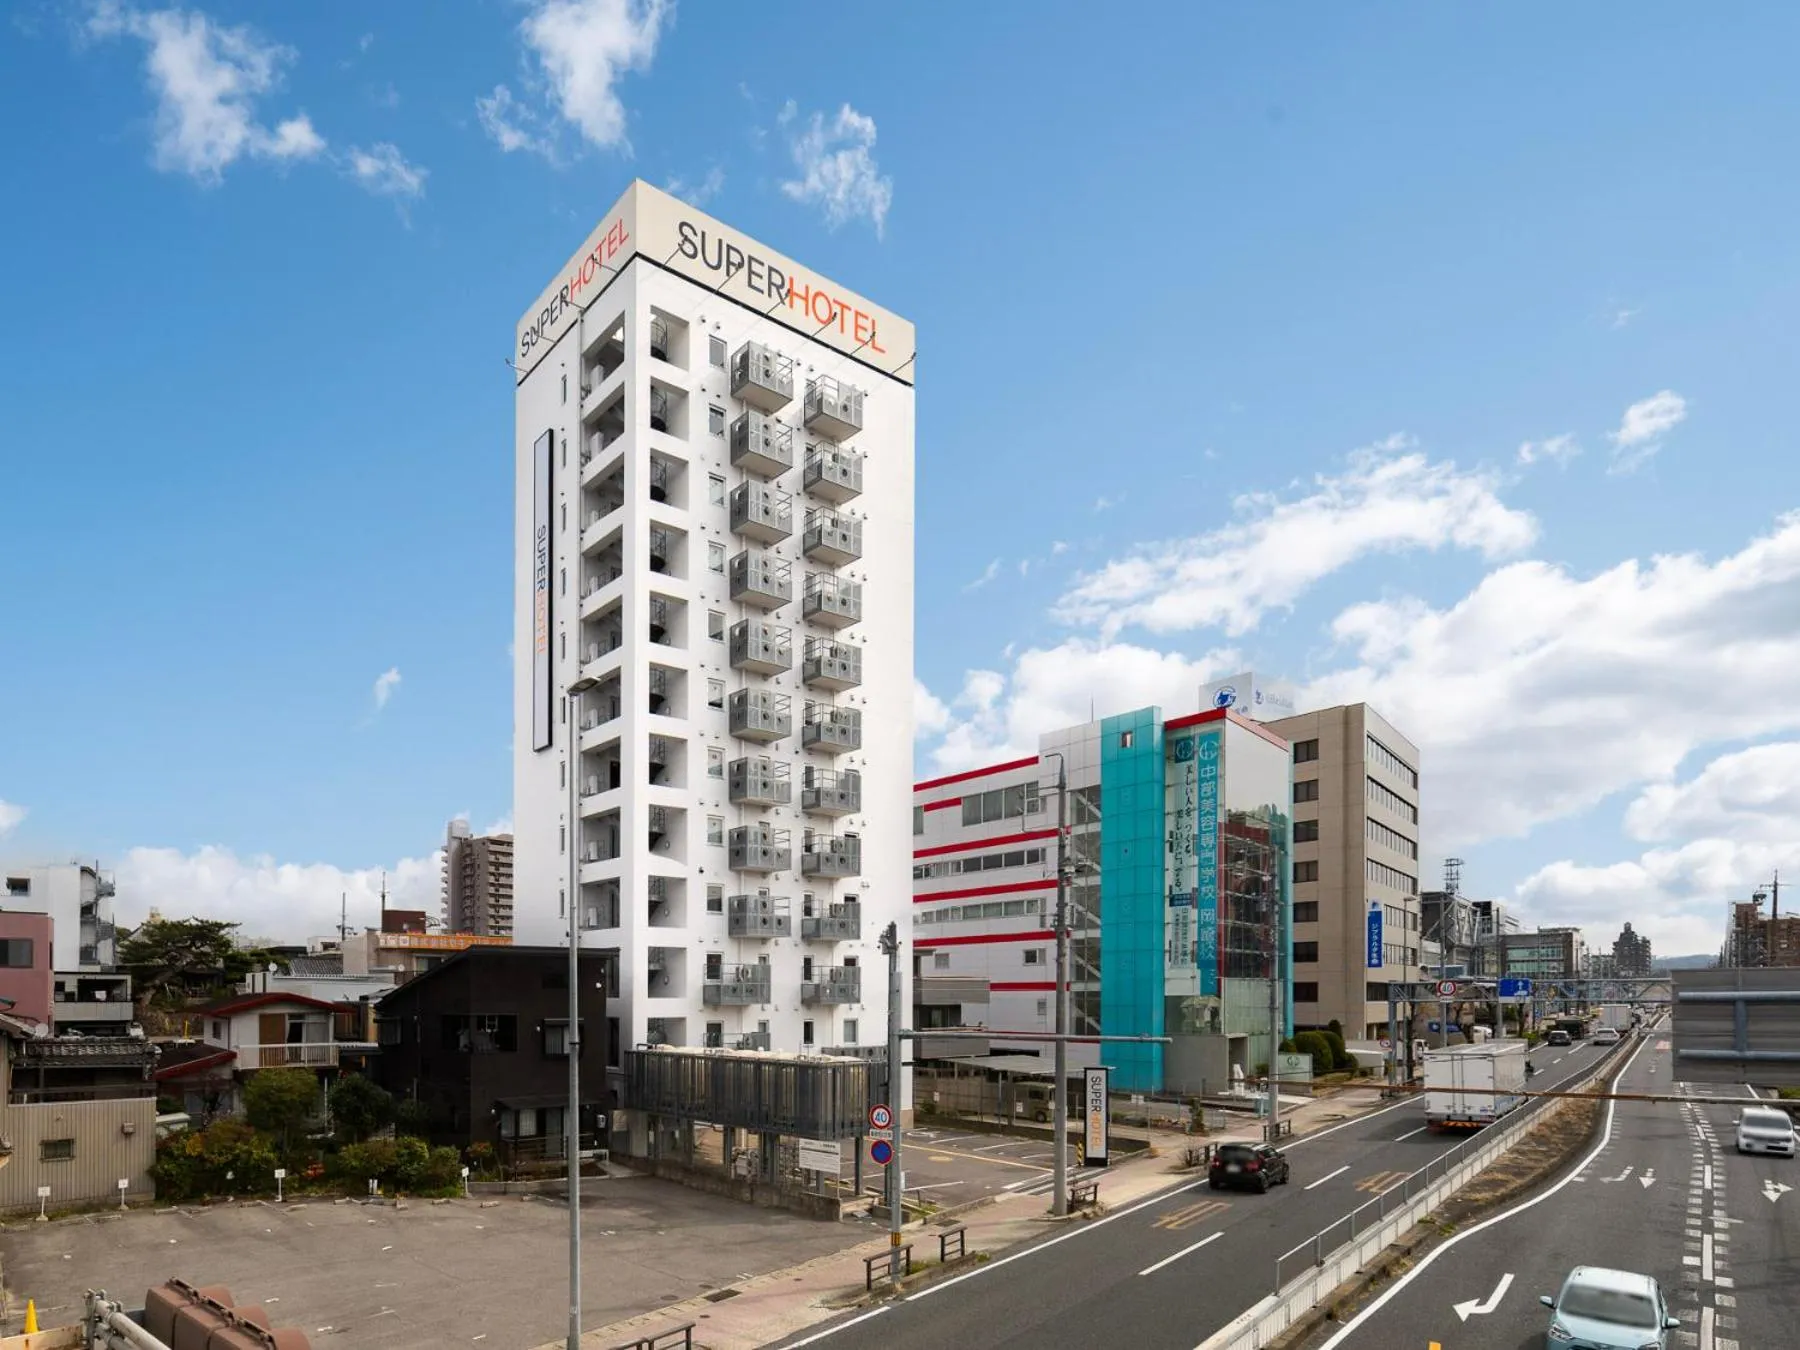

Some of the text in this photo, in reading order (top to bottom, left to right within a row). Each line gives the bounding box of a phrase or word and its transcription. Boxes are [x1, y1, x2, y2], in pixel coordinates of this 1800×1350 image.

[521, 218, 629, 358] SUPERHOTEL
[678, 221, 886, 354] SUPERHOTEL
[875, 1111, 888, 1123] 40
